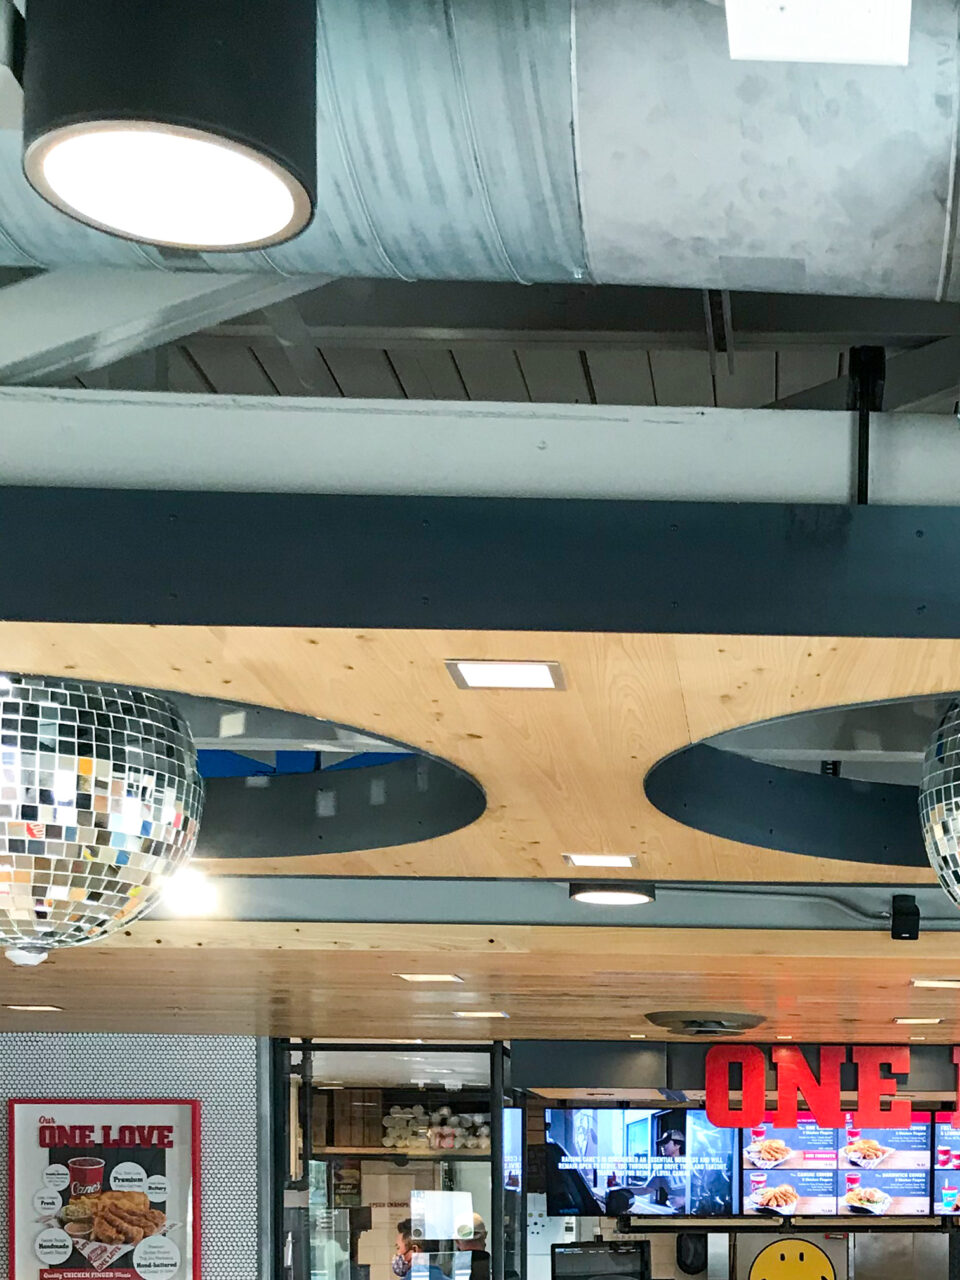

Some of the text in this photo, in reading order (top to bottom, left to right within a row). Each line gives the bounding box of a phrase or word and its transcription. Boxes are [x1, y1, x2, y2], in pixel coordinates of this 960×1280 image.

[705, 1045, 911, 1130] ONE
[38, 1115, 55, 1124] Our
[39, 1125, 174, 1149] ONE LOVE
